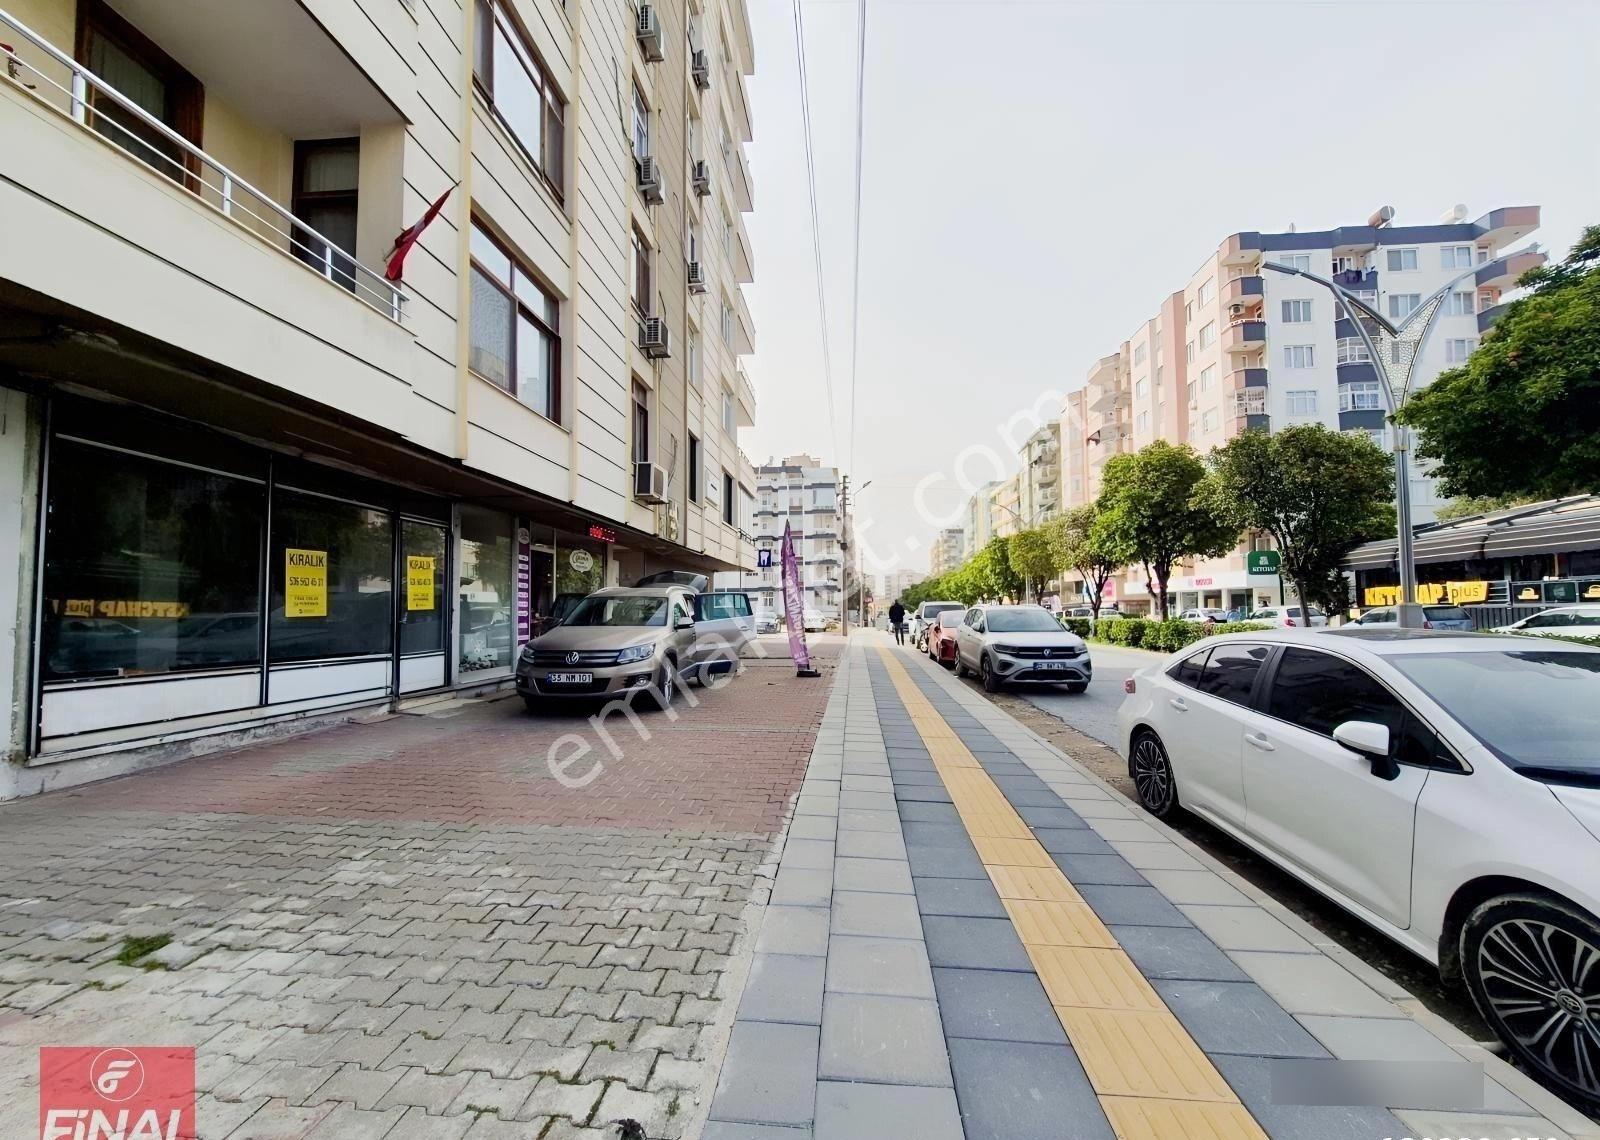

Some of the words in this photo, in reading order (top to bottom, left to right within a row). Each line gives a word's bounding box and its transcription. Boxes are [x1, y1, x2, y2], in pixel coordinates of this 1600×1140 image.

[288, 553, 325, 568] KIRALIK
[1364, 583, 1444, 606] KETCAP
[1451, 587, 1480, 602] plus
